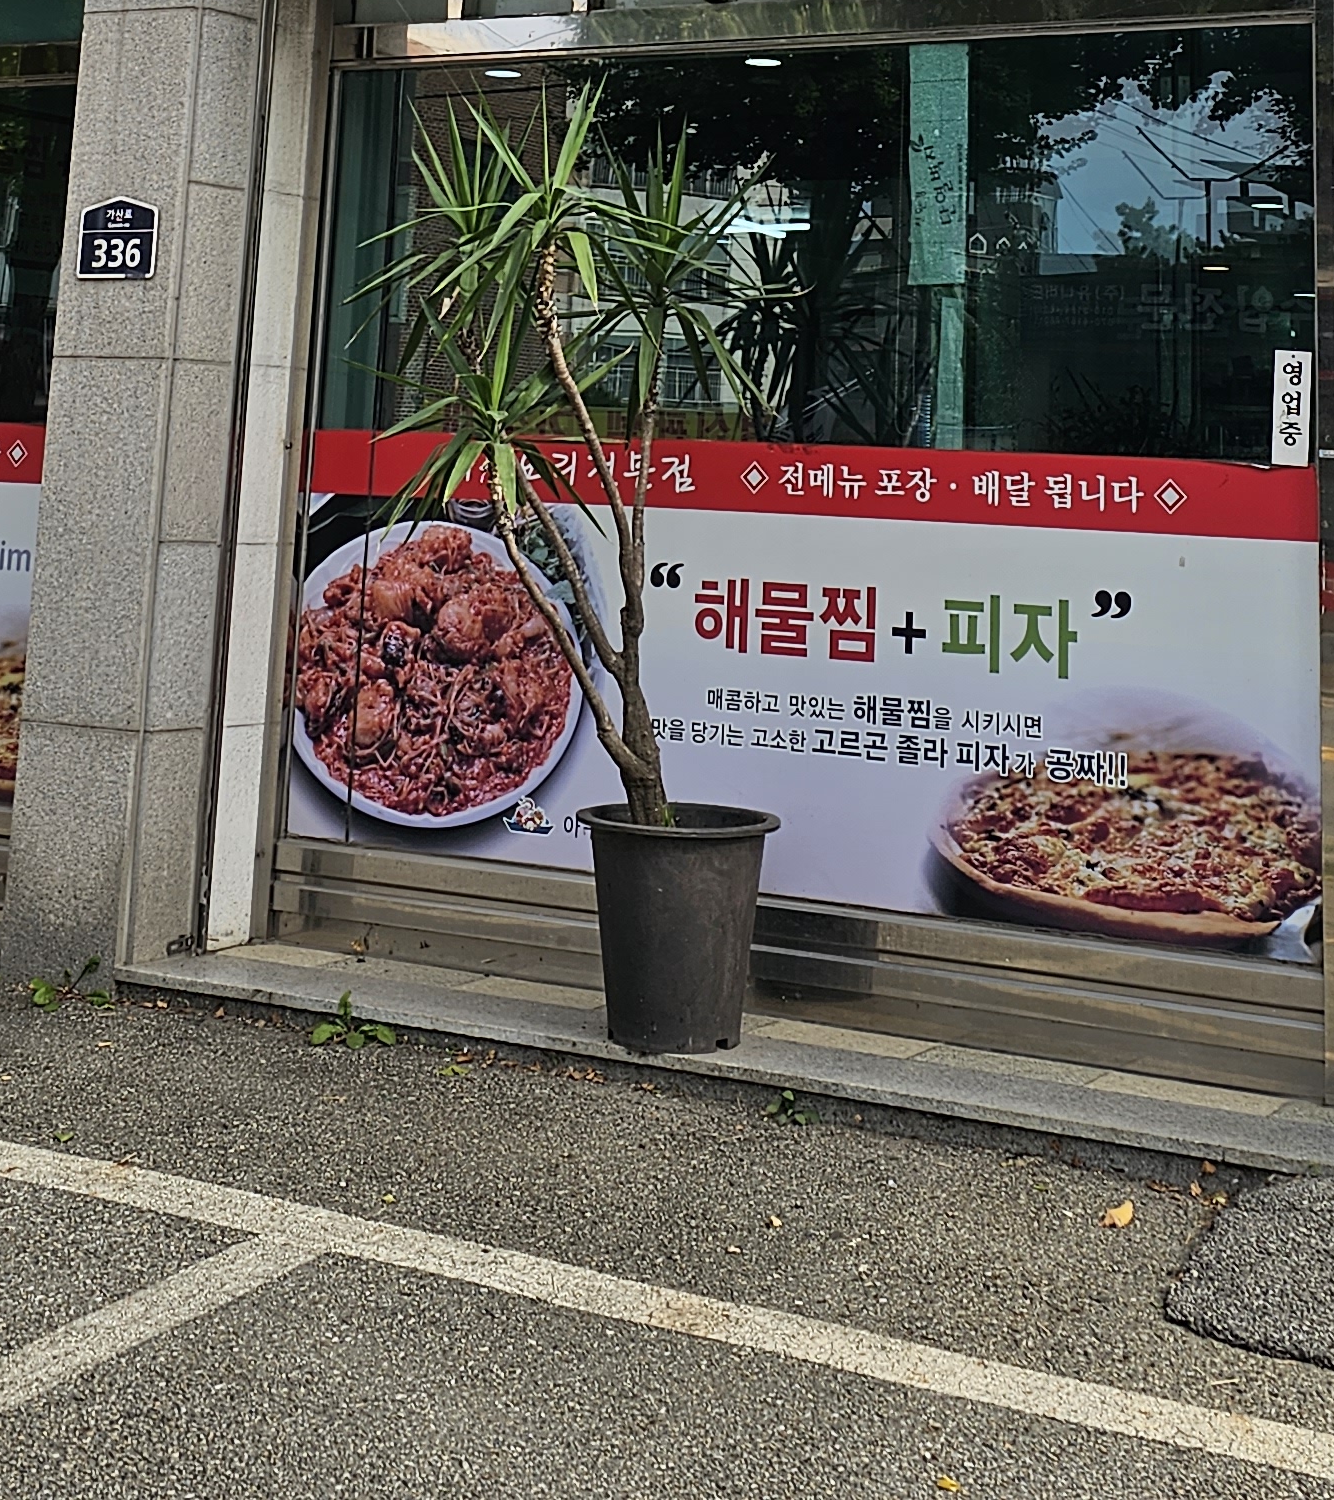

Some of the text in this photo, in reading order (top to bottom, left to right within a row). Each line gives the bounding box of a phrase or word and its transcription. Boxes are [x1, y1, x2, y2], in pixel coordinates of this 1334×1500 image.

[91, 238, 141, 268] 336
[1278, 361, 1303, 448] 영업중
[778, 462, 1144, 514] 전메뉴 포장 배달 됩니다
[707, 688, 1043, 739] 매콤하고 맛있는 해물찜을 시키시면
[651, 718, 1127, 787] 맛을 당기는 고소한 고르곤 졸라 피자가 공짜!!
